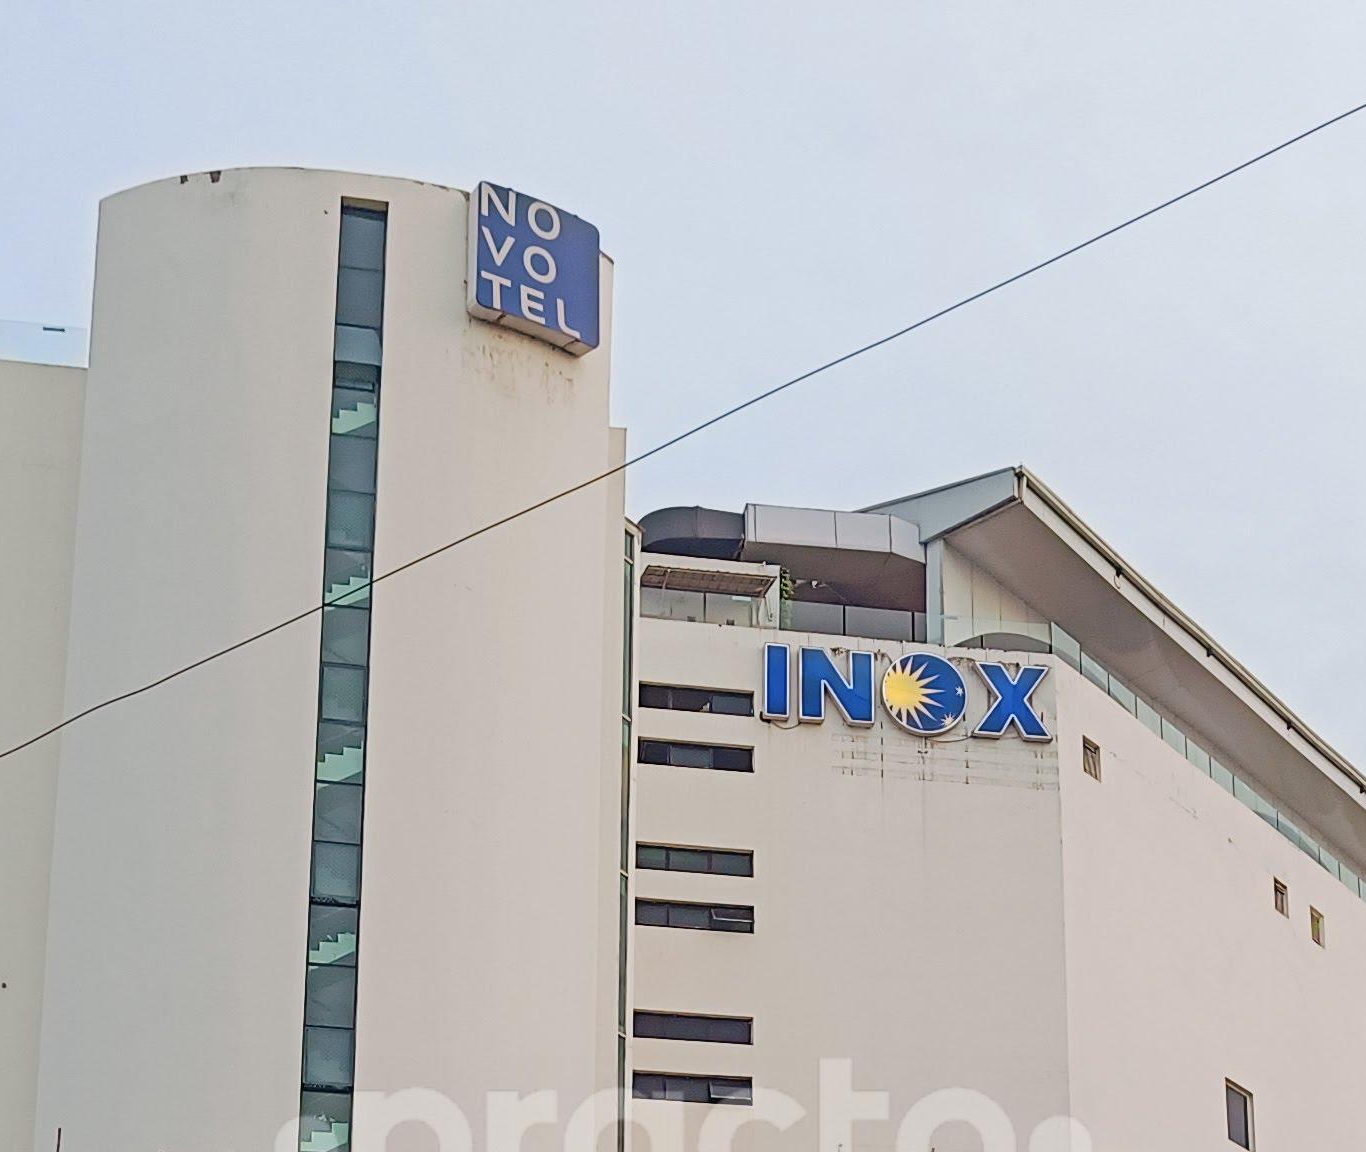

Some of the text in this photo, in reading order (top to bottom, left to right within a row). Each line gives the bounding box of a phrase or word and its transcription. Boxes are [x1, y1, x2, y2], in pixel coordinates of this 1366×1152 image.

[481, 183, 561, 241] NO
[481, 225, 557, 284] VO
[480, 270, 581, 339] TEL
[764, 642, 1053, 742] INOX
